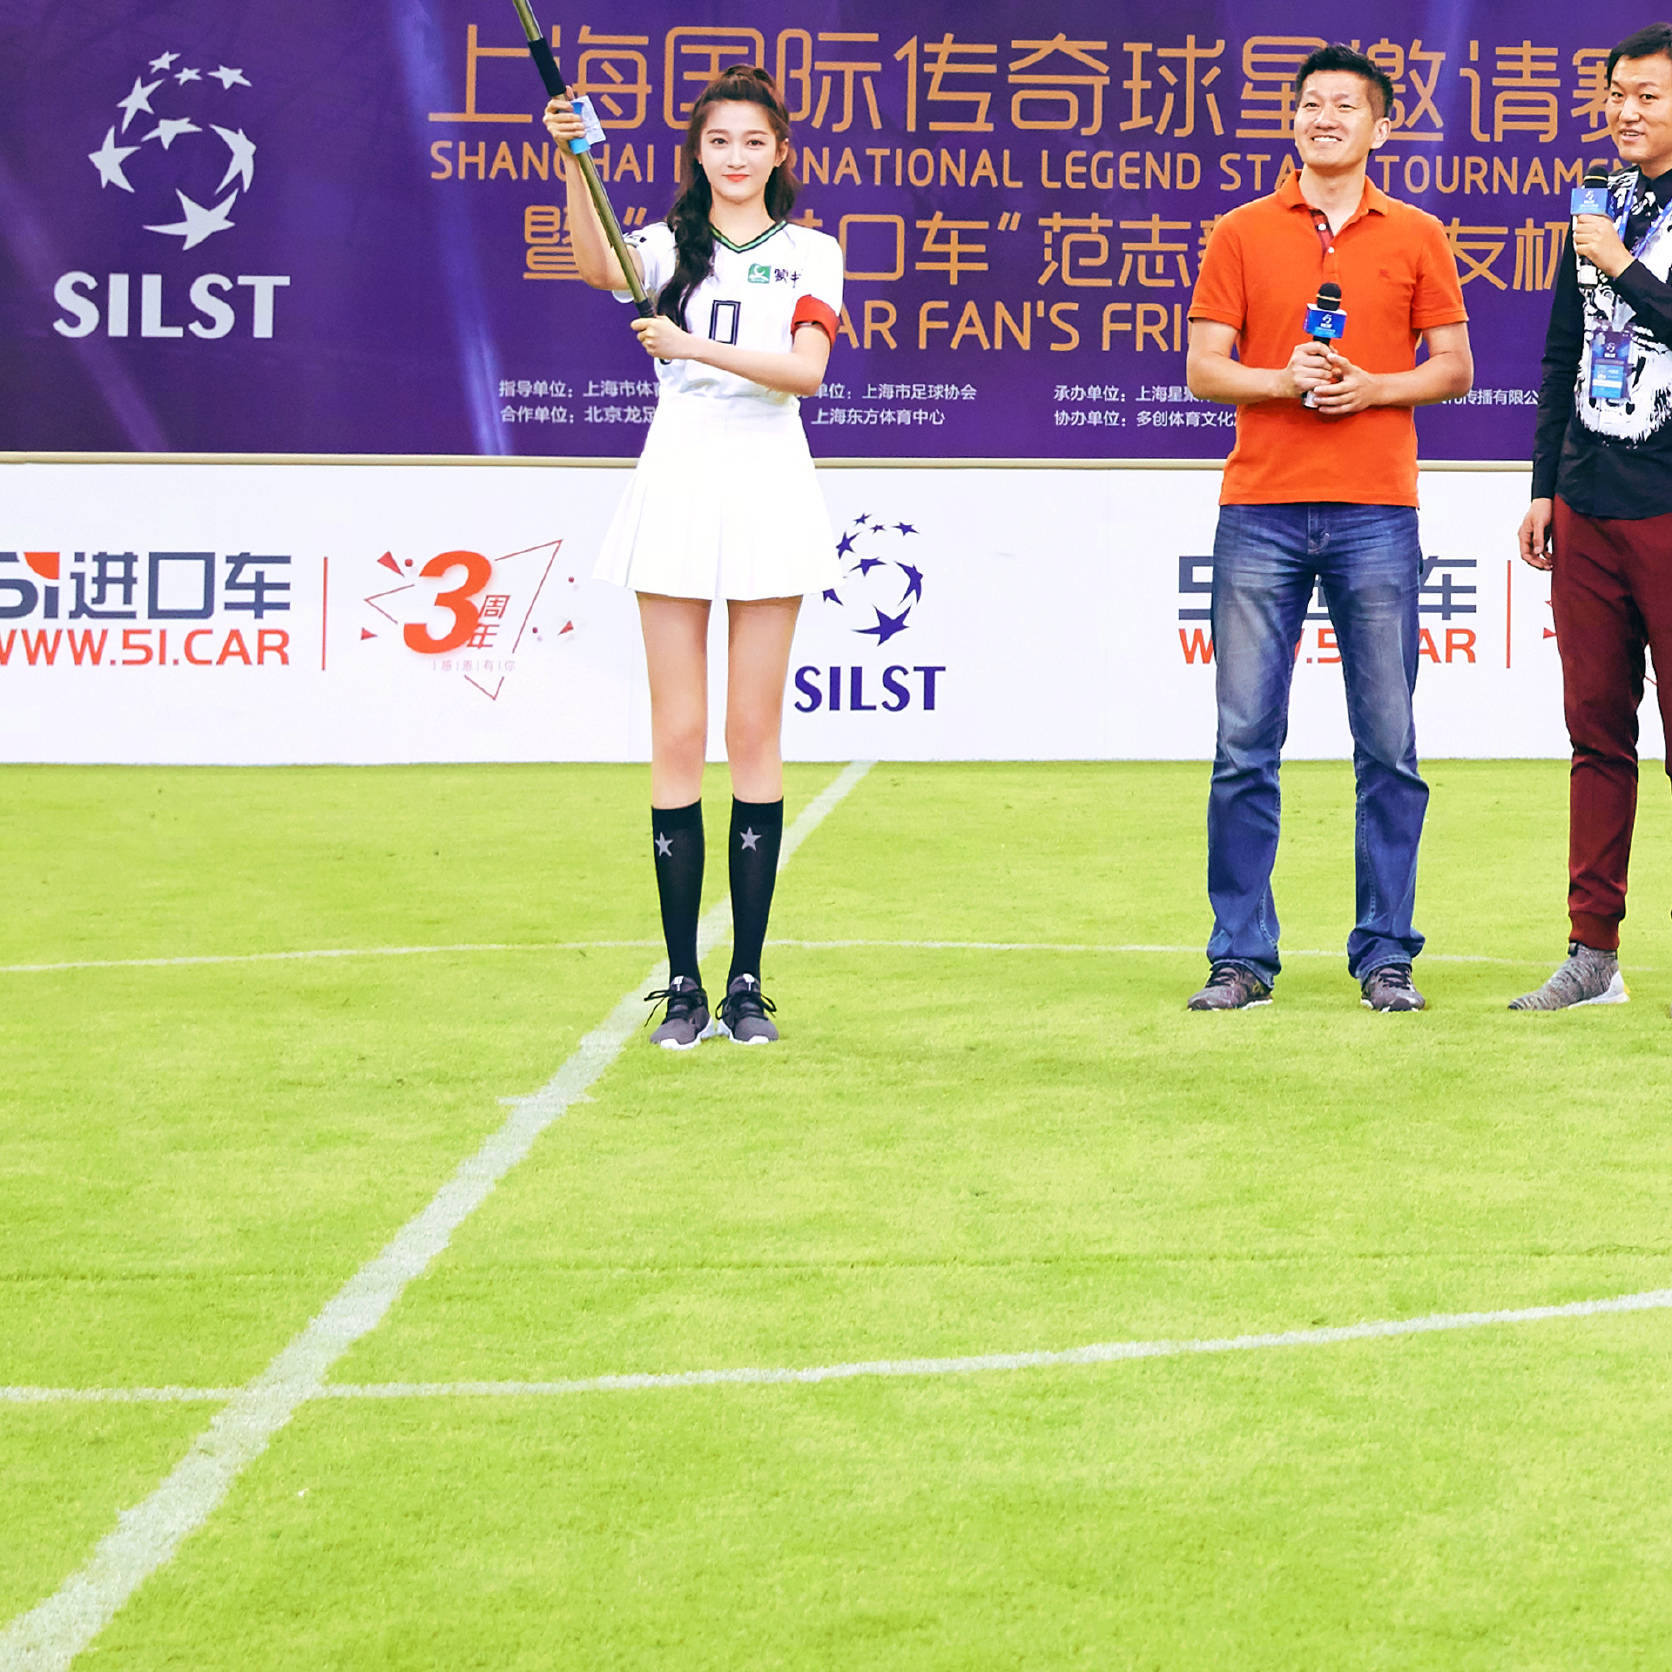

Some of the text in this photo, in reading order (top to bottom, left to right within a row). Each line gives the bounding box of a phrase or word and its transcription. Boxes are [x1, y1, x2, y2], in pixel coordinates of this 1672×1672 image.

[1042, 149, 1201, 191] LEGEND
[1220, 153, 1297, 191] STA
[1376, 155, 1624, 195] TOURNAM
[53, 272, 291, 340] SILST
[919, 300, 1080, 353] FAN'S
[1102, 303, 1184, 353] FRI
[810, 407, 946, 426] 上海东方体育中心
[403, 549, 493, 655] 3
[794, 665, 947, 712] SILST
